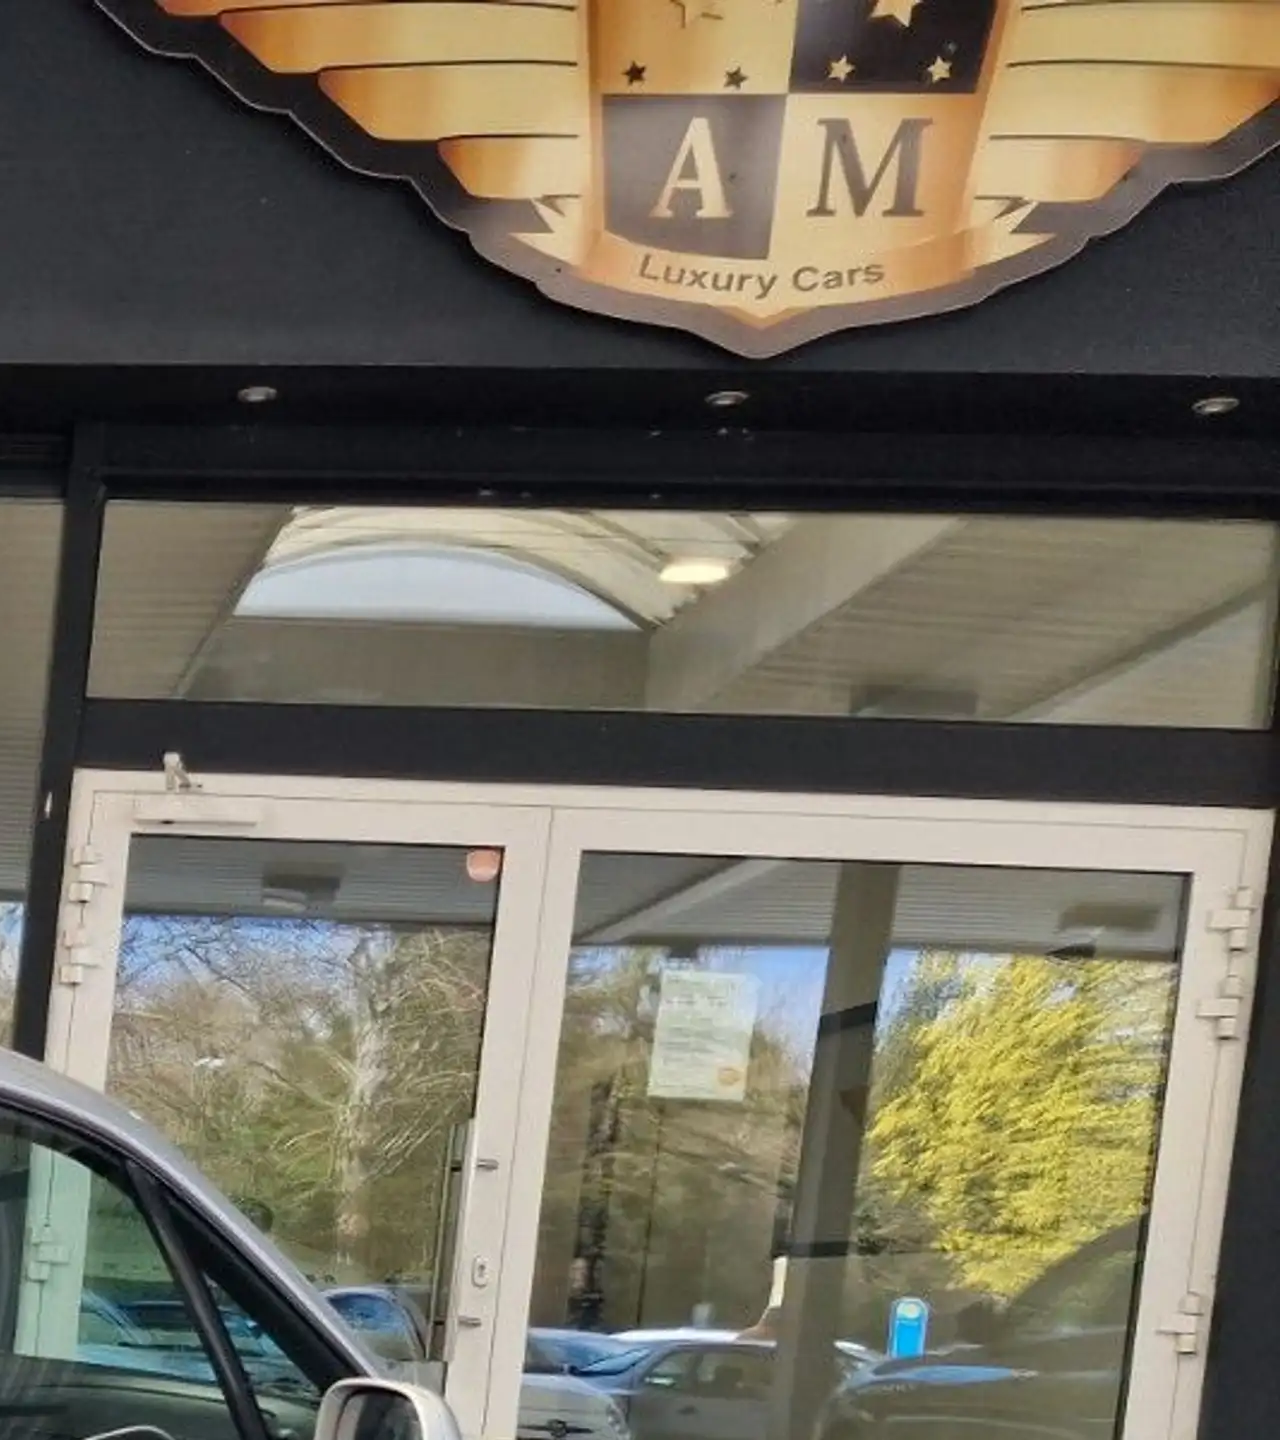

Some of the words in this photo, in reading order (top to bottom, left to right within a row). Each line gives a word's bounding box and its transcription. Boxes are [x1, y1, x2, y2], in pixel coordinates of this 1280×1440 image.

[649, 116, 733, 218] A
[806, 117, 933, 217] M
[639, 254, 778, 299] Luxury
[792, 263, 886, 292] Cars
